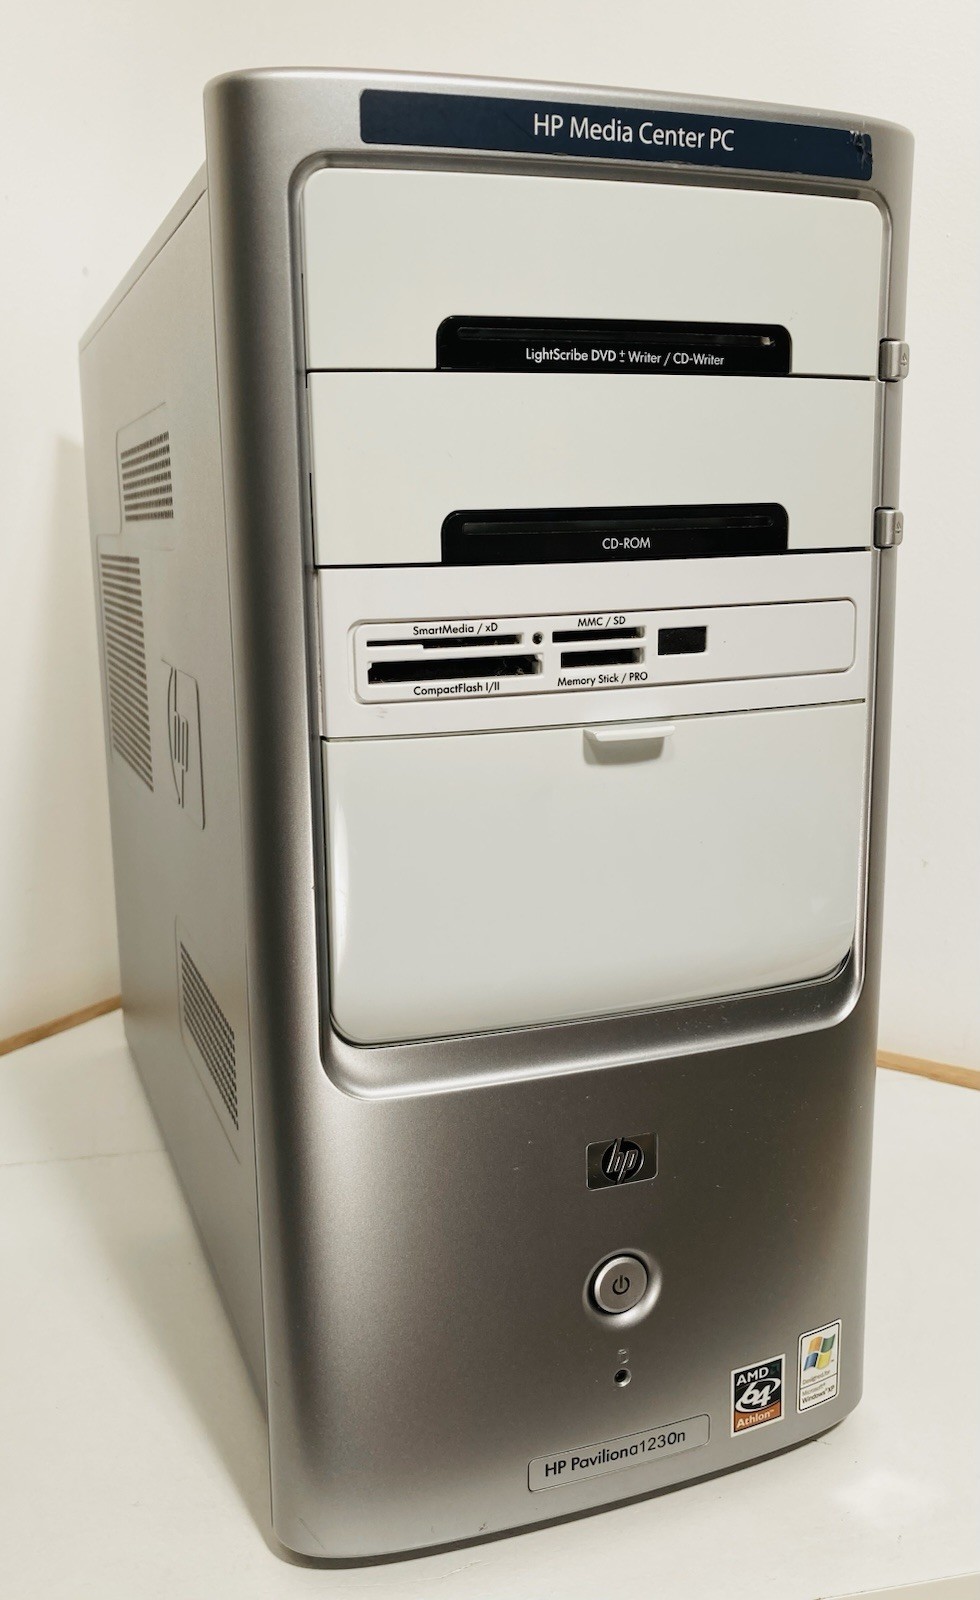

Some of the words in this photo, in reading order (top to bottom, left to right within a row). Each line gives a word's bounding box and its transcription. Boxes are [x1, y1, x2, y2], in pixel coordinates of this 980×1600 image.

[533, 112, 563, 137] HP
[570, 116, 634, 144] Media
[638, 121, 705, 149] Center
[709, 128, 735, 152] PC
[525, 347, 588, 363] LightScribe
[591, 349, 616, 361] DVD
[628, 350, 661, 364] Writer
[673, 352, 725, 366] CD-Writer
[602, 536, 651, 550] CD-ROM
[412, 624, 475, 636] SmartMedia
[485, 622, 499, 632] xD
[577, 616, 603, 627] MMC
[613, 615, 626, 626] SD
[557, 674, 595, 688] Memory
[598, 672, 620, 684] Stick
[628, 670, 648, 682] PRO
[413, 683, 483, 697] CompactFlash
[485, 681, 500, 694] I/II
[736, 1366, 769, 1386] AMD
[740, 1381, 771, 1407] 64
[545, 1460, 567, 1477] HP
